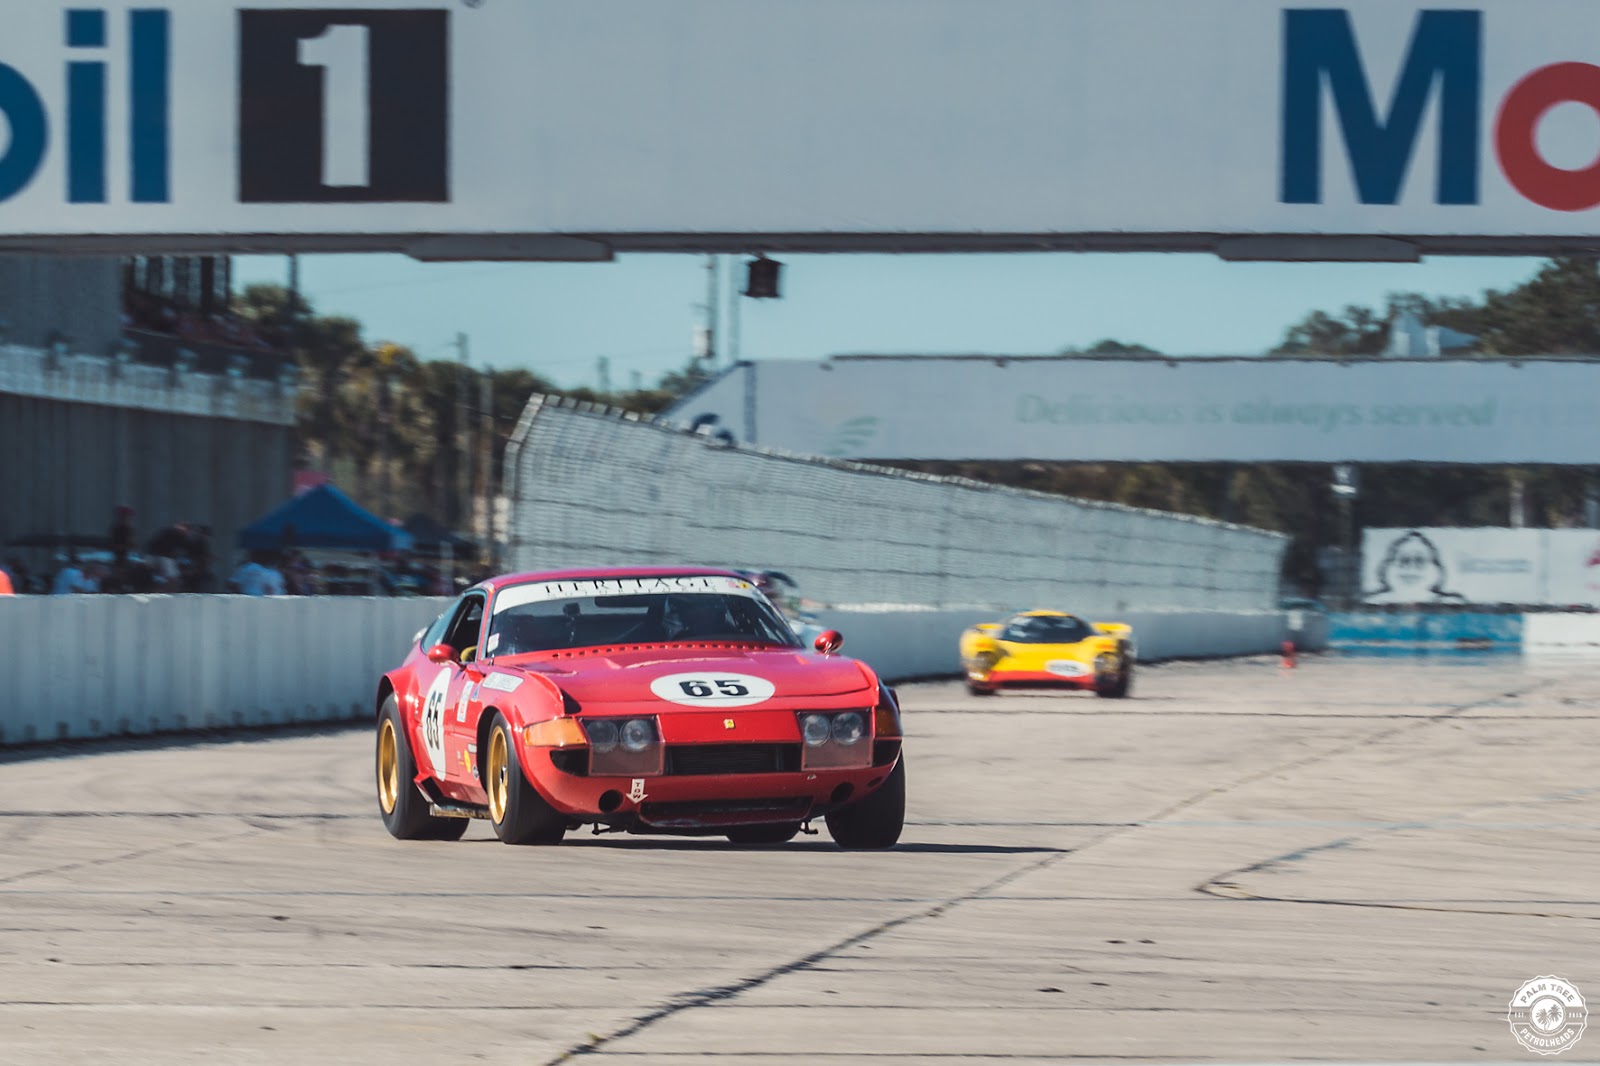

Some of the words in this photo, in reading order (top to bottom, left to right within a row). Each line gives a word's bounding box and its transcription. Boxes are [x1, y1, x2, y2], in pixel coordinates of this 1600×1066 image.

[297, 24, 370, 188] 1
[1280, 9, 1600, 212] Mo
[1015, 393, 1184, 424] Delicious
[1193, 394, 1224, 424] is
[1232, 392, 1362, 434] always
[1370, 393, 1498, 426] served
[545, 577, 713, 595] HERITAGE
[679, 679, 749, 697] 65
[426, 691, 444, 751] 65
[632, 781, 642, 799] TOW
